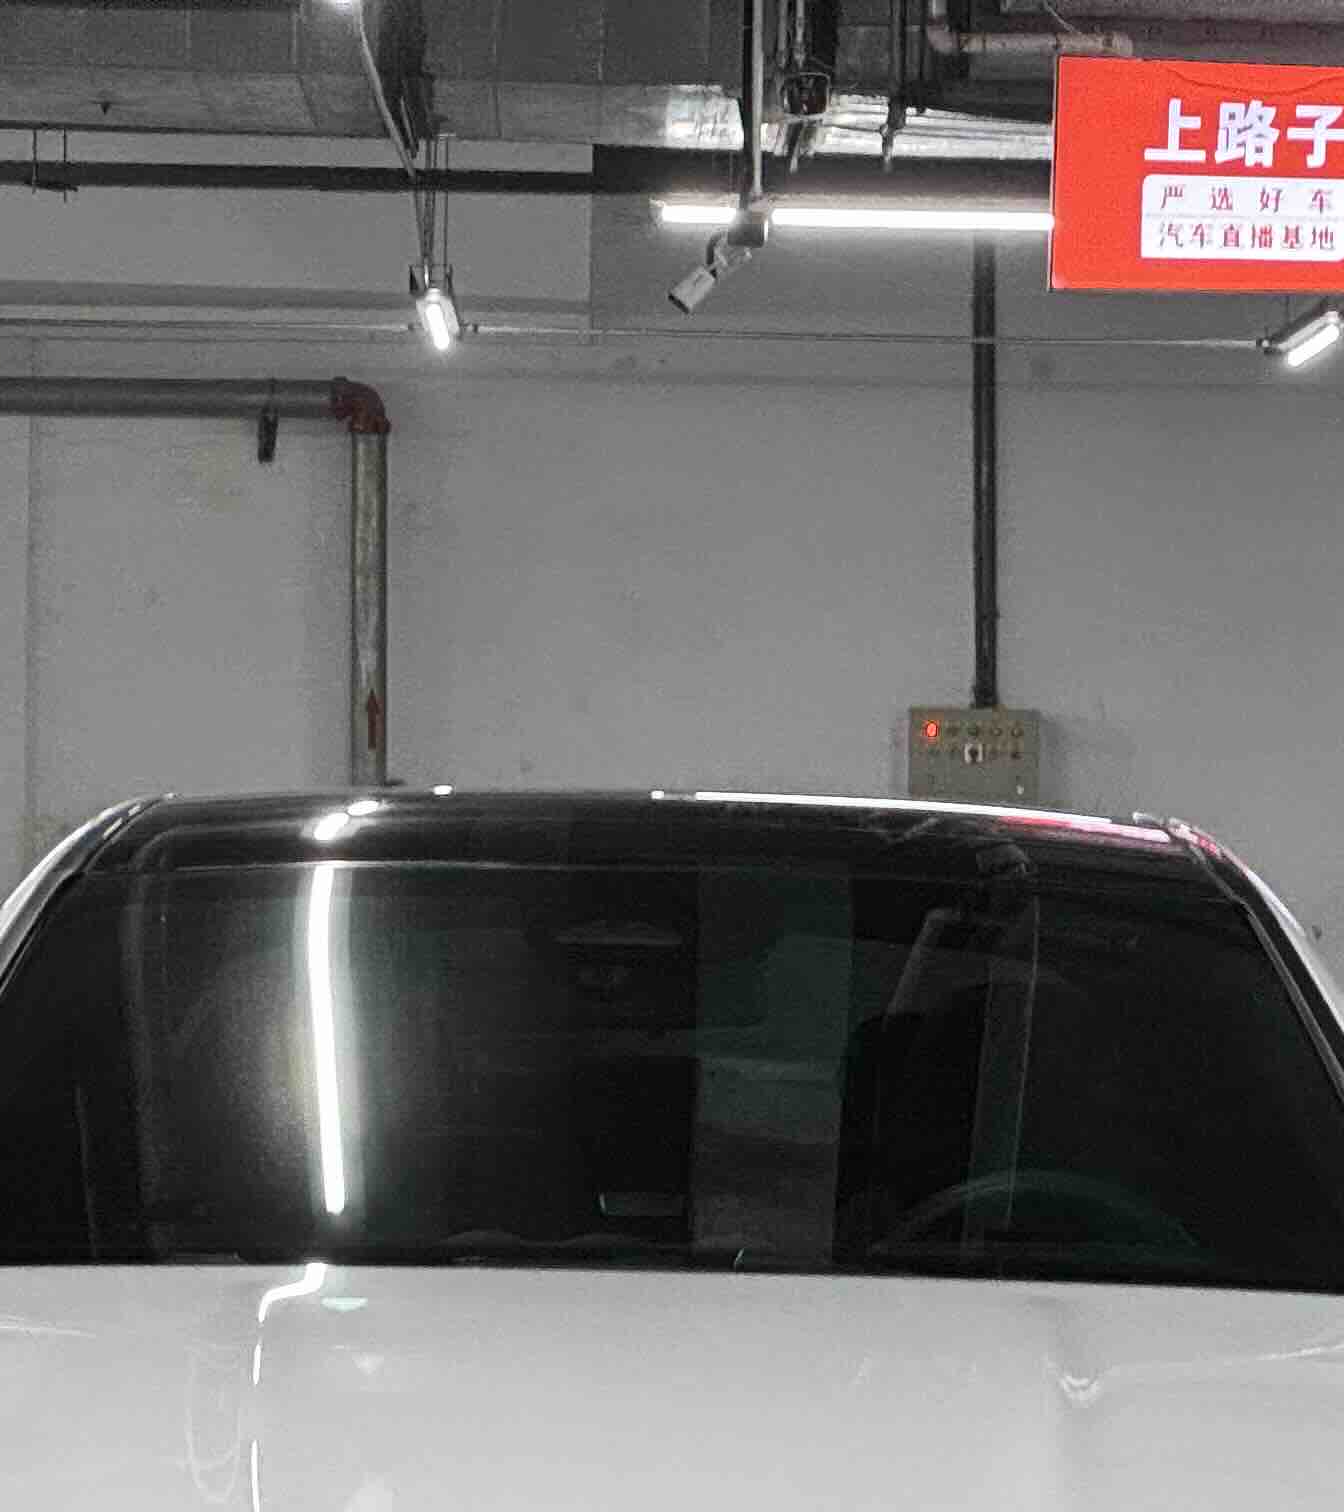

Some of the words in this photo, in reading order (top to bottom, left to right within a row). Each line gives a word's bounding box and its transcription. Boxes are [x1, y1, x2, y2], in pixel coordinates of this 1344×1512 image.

[1160, 183, 1333, 214] 严选好车
[1159, 222, 1335, 250] 汽车直播基地
